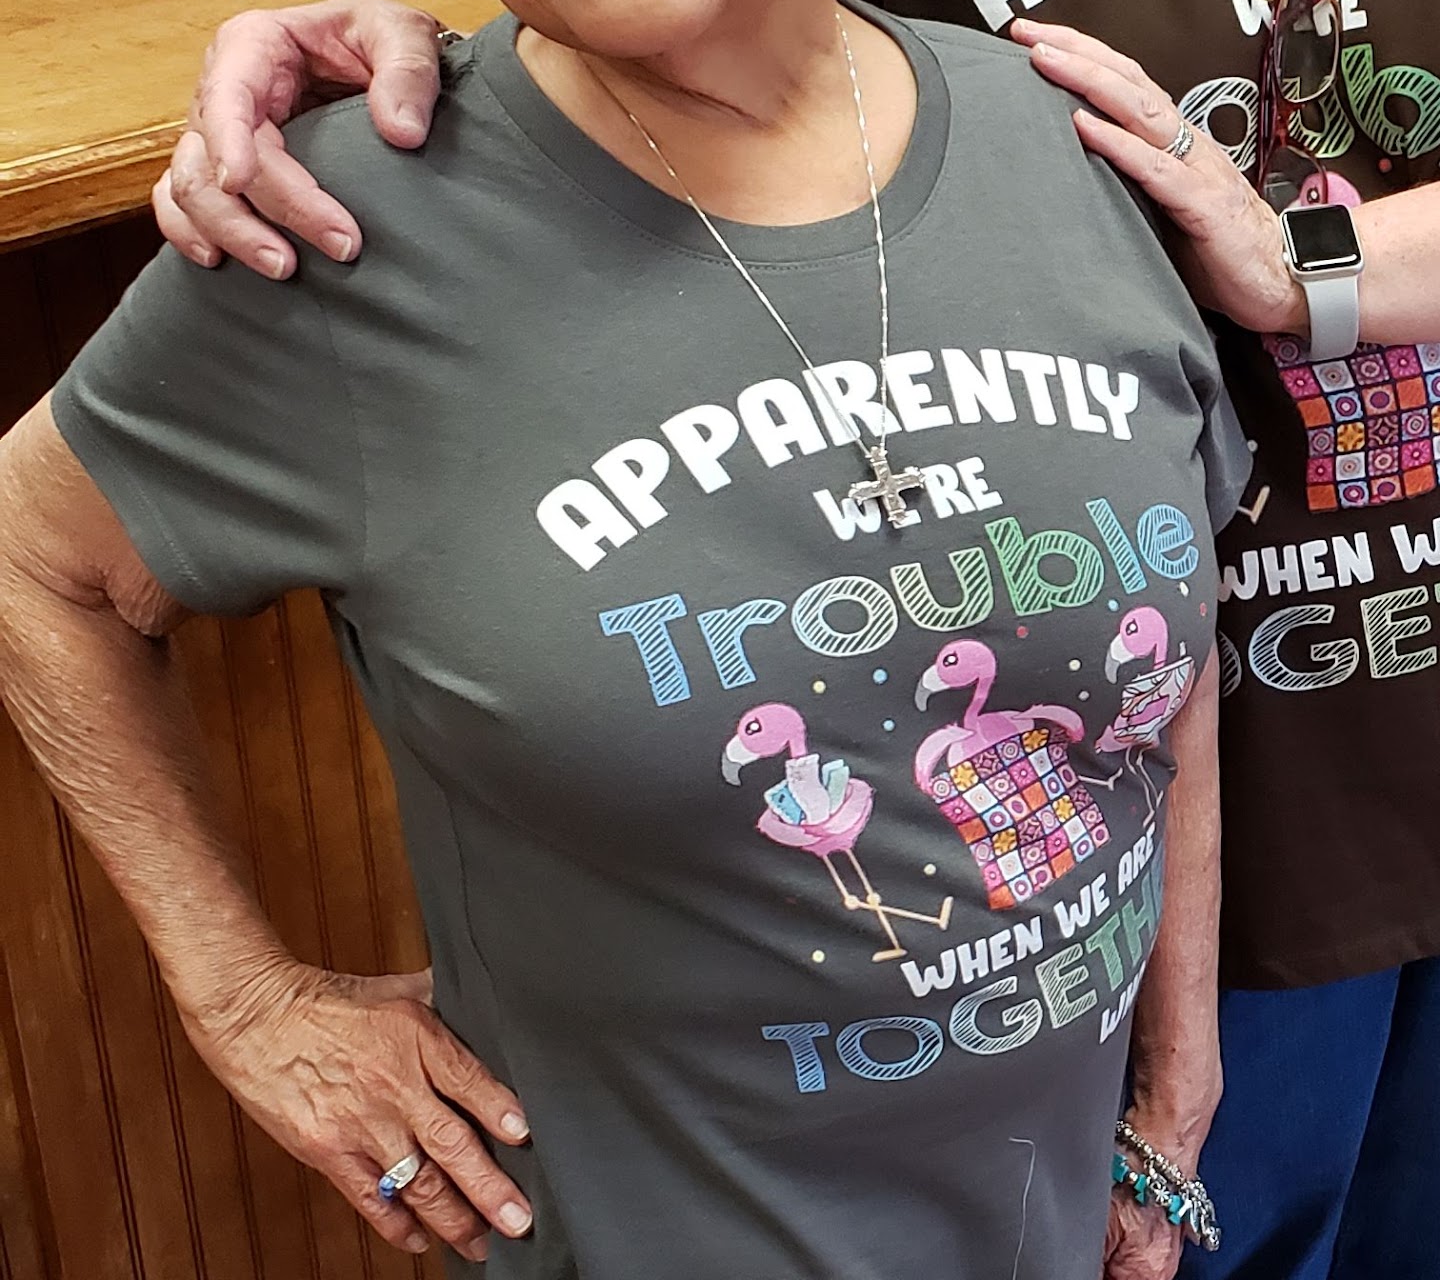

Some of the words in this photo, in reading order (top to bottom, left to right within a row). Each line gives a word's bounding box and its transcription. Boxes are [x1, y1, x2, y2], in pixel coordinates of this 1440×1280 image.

[536, 348, 1140, 572] APPARENTLY
[600, 498, 1198, 707] Trouble
[1218, 532, 1374, 601] WHEN
[901, 916, 1044, 997] WHEN
[1054, 872, 1111, 940] WE
